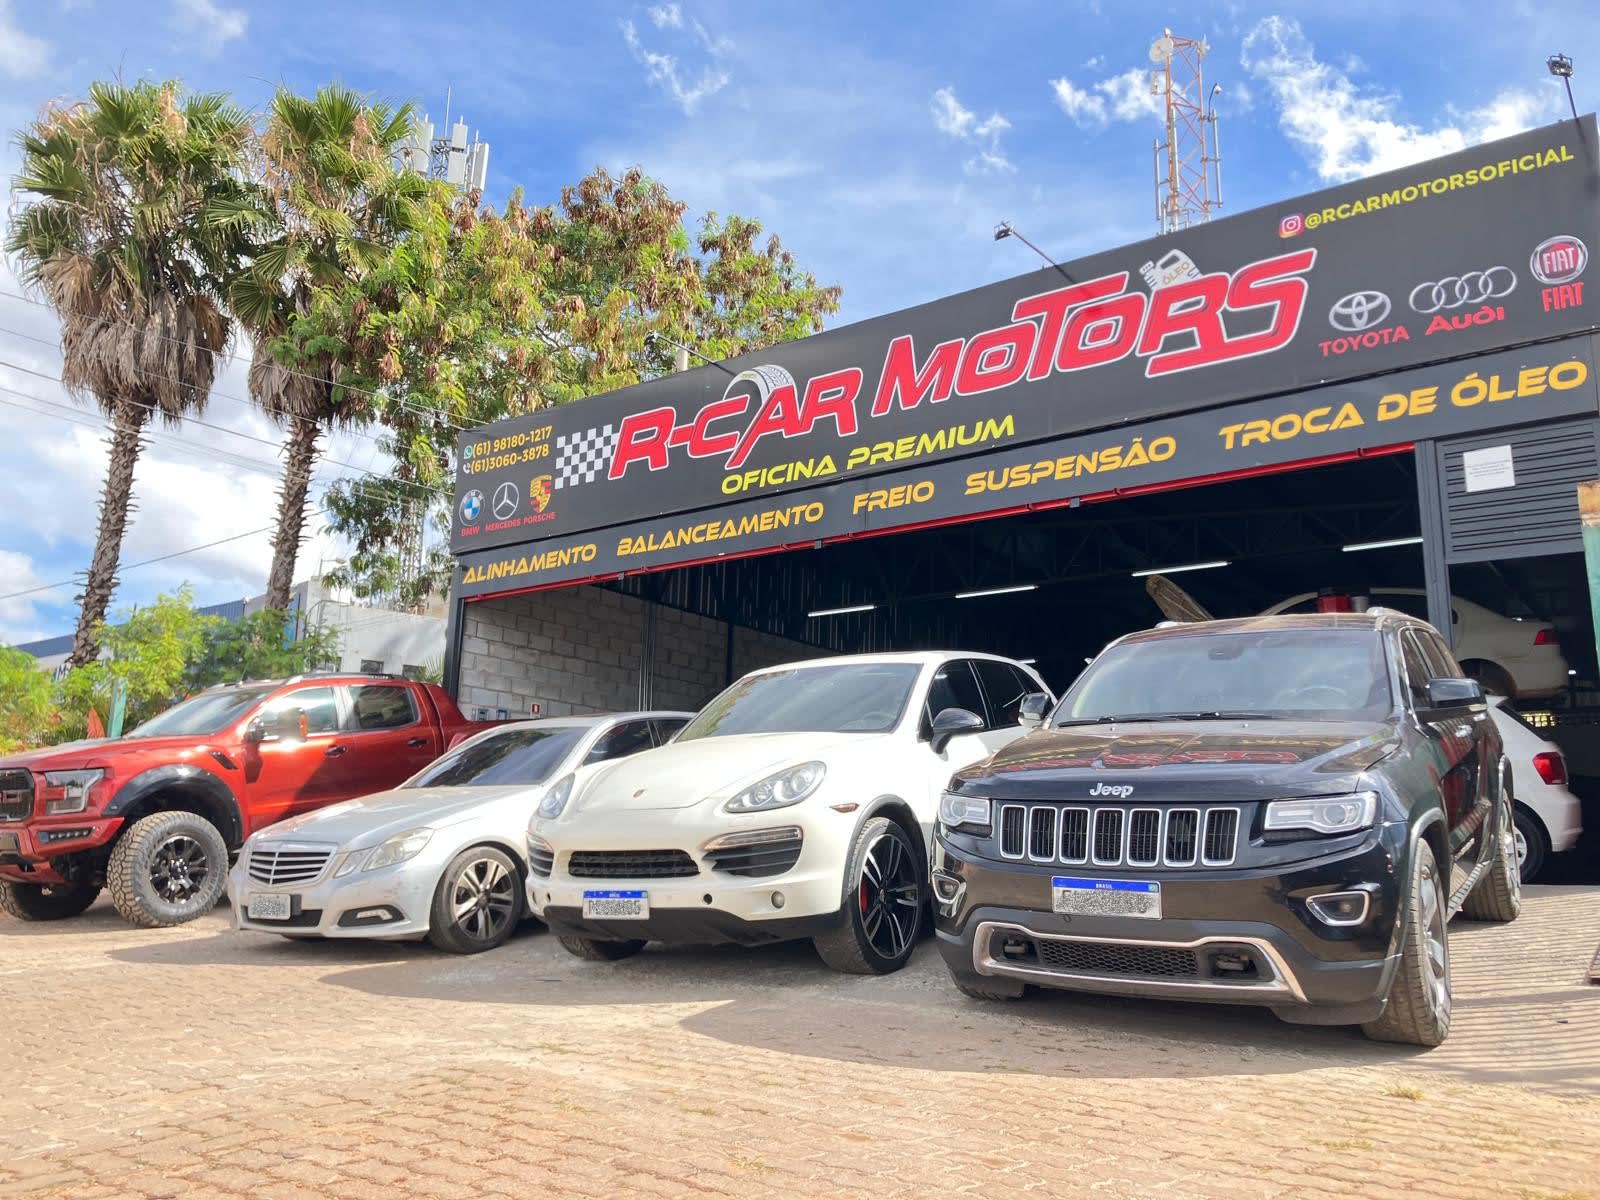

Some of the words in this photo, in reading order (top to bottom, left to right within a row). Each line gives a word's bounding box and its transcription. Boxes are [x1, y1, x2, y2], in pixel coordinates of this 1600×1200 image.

[1304, 145, 1575, 230] @RCARMOTORSOFICIAL
[1543, 247, 1575, 274] FIAT
[1541, 281, 1584, 313] FIAT
[1318, 324, 1410, 358] TOYOTA
[608, 367, 863, 480] R-CAR
[871, 248, 1317, 418] MOTORS
[472, 440, 491, 459] (61)
[493, 425, 553, 452] 98180-1217
[721, 455, 838, 495] OFICINA
[847, 414, 1015, 470] PREMIUM
[463, 543, 597, 585] ALINHAMENTO
[616, 501, 824, 557] BALANCEAMENTO
[852, 480, 935, 515] FREIO
[964, 437, 1177, 496] SUSPENSÃO
[1218, 402, 1365, 450] TROCA
[1376, 386, 1439, 422] DE
[1450, 361, 1588, 408] ÓLEO
[461, 525, 480, 537] BMW
[485, 518, 521, 532] MERCEDES
[523, 511, 557, 525] PORSCHE
[1089, 782, 1134, 798] Jeep
